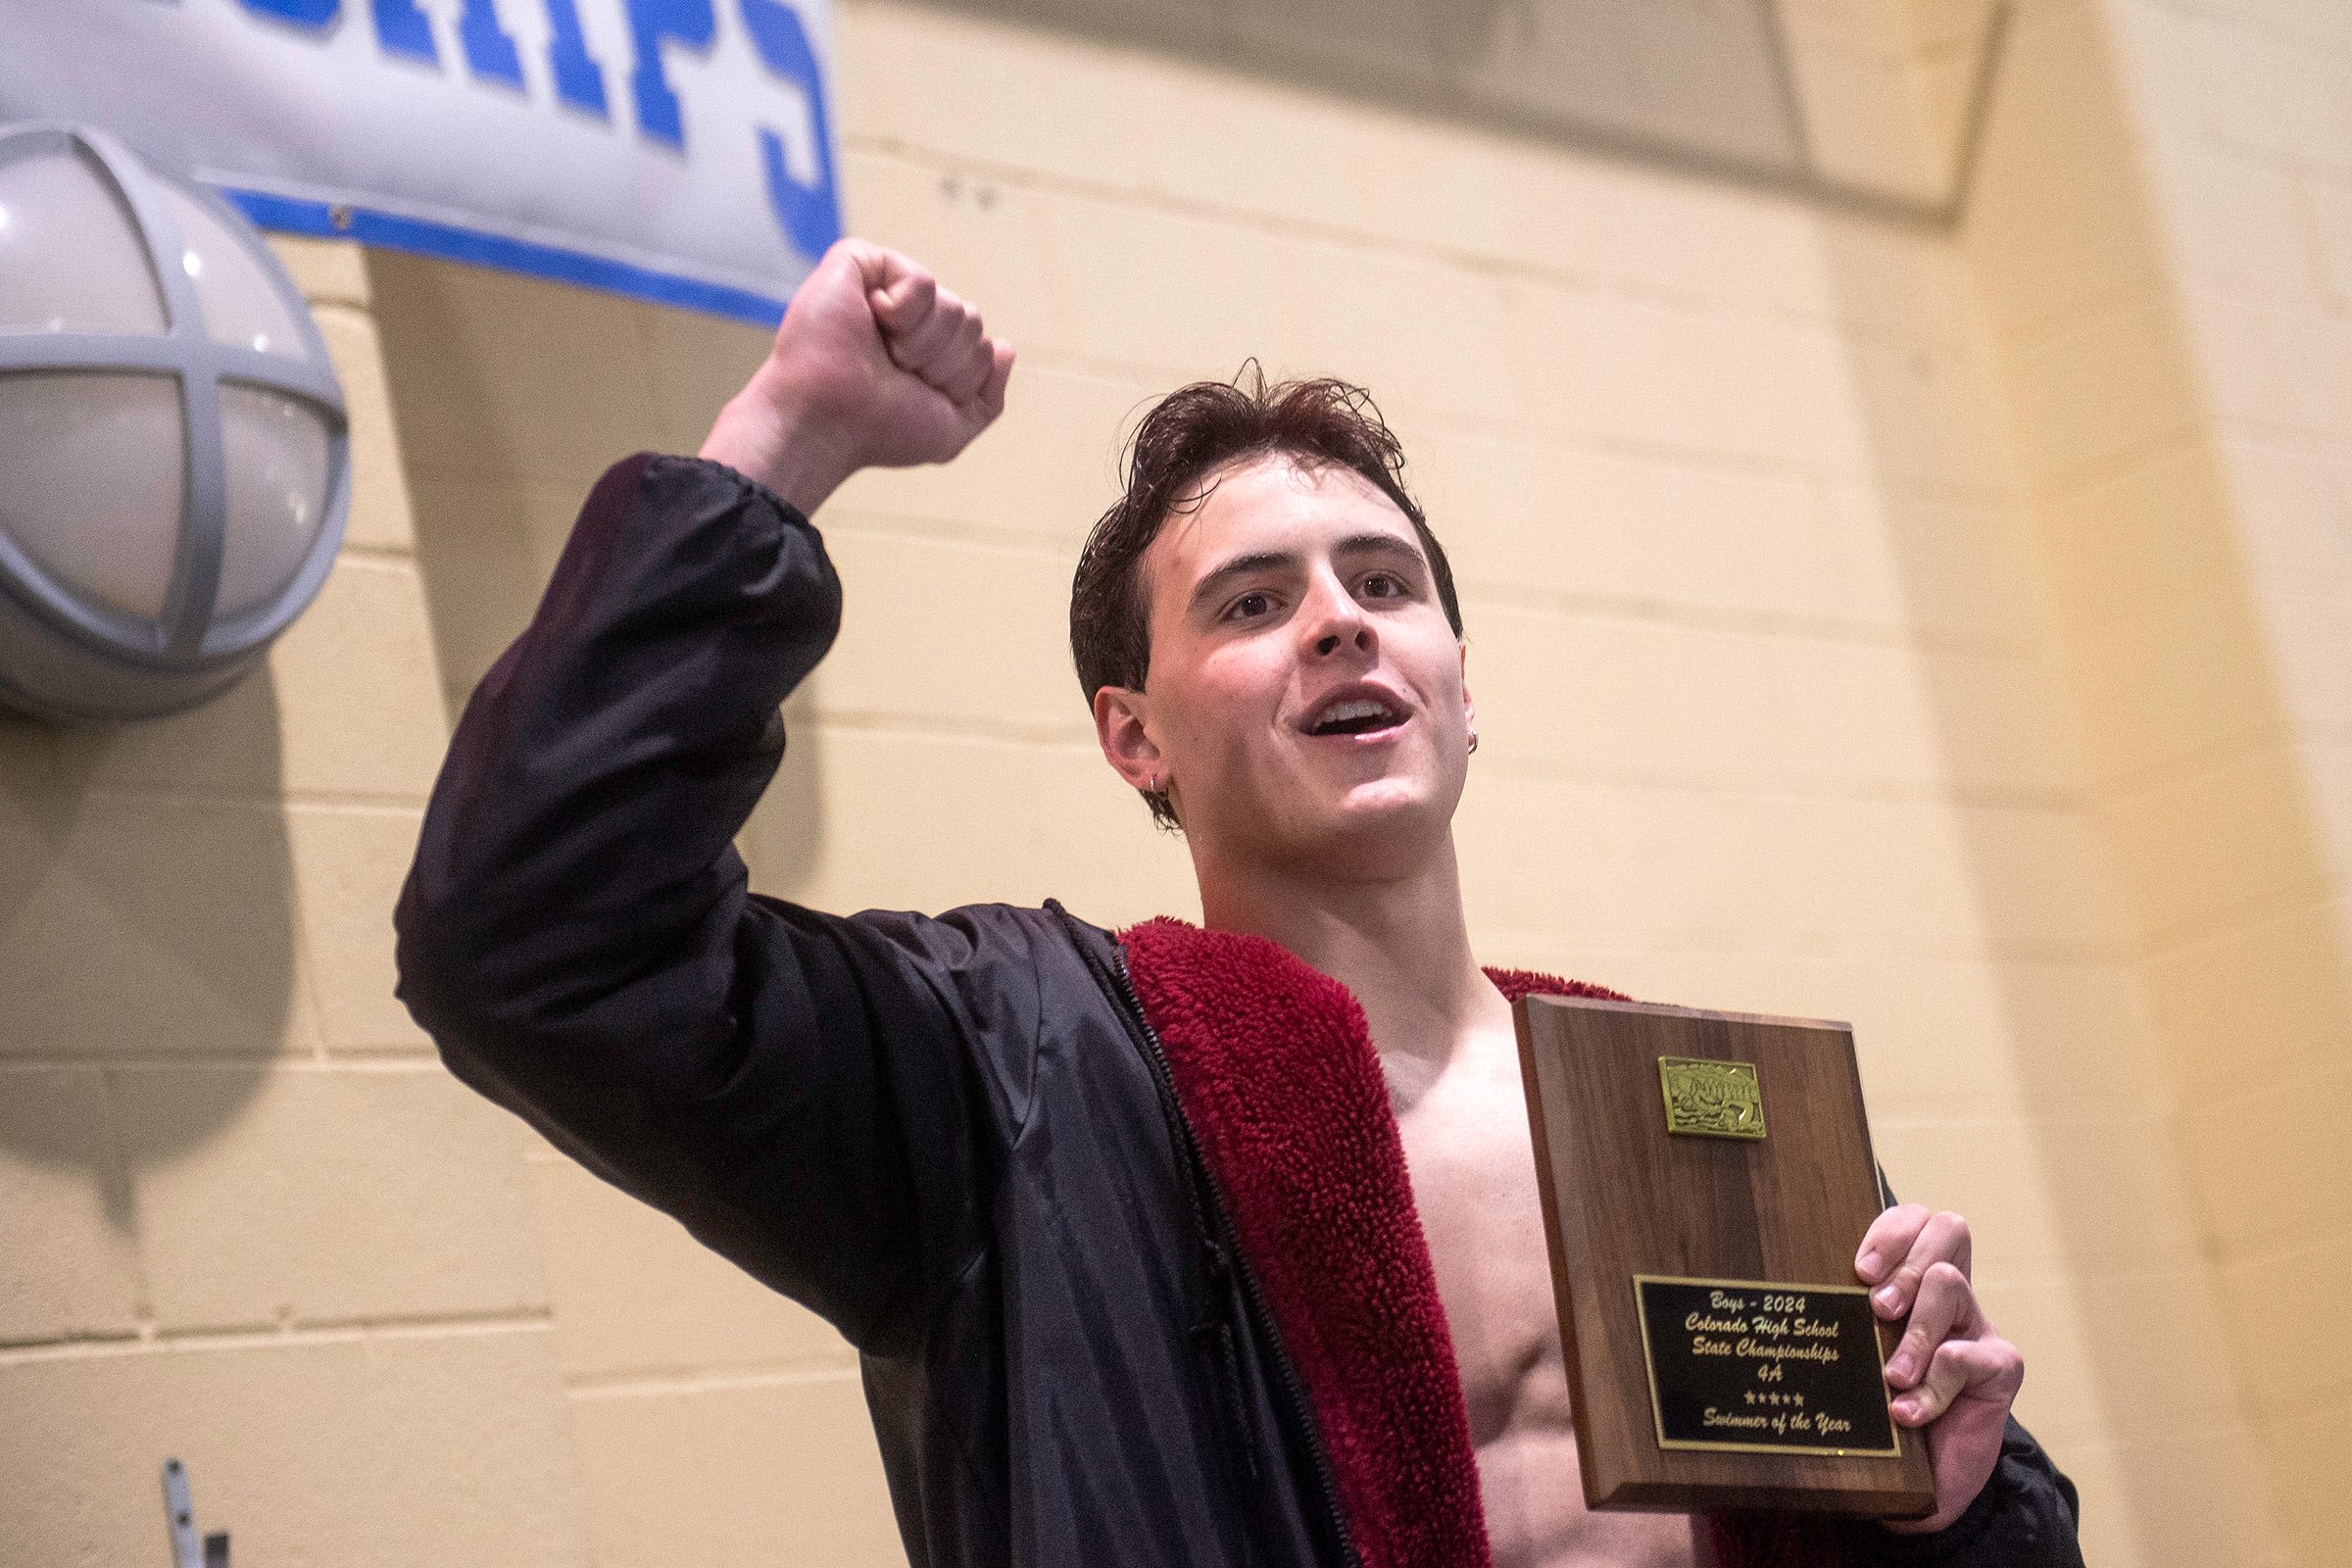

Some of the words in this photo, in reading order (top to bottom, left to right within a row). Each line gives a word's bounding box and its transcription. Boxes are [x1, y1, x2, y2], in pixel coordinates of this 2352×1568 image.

[1710, 1291, 1744, 1313] Boys
[1763, 1295, 1805, 1313] 2024
[1685, 1312, 1747, 1334] Colorado
[1751, 1316, 1789, 1340] High
[1792, 1320, 1838, 1338] School
[1692, 1336, 1732, 1355] State
[1736, 1338, 1839, 1365] Championships
[1757, 1363, 1783, 1382] 4A
[1703, 1407, 1767, 1427] Swimmer
[1771, 1412, 1786, 1435] of
[1789, 1412, 1810, 1430] the
[1815, 1412, 1851, 1436] Year
